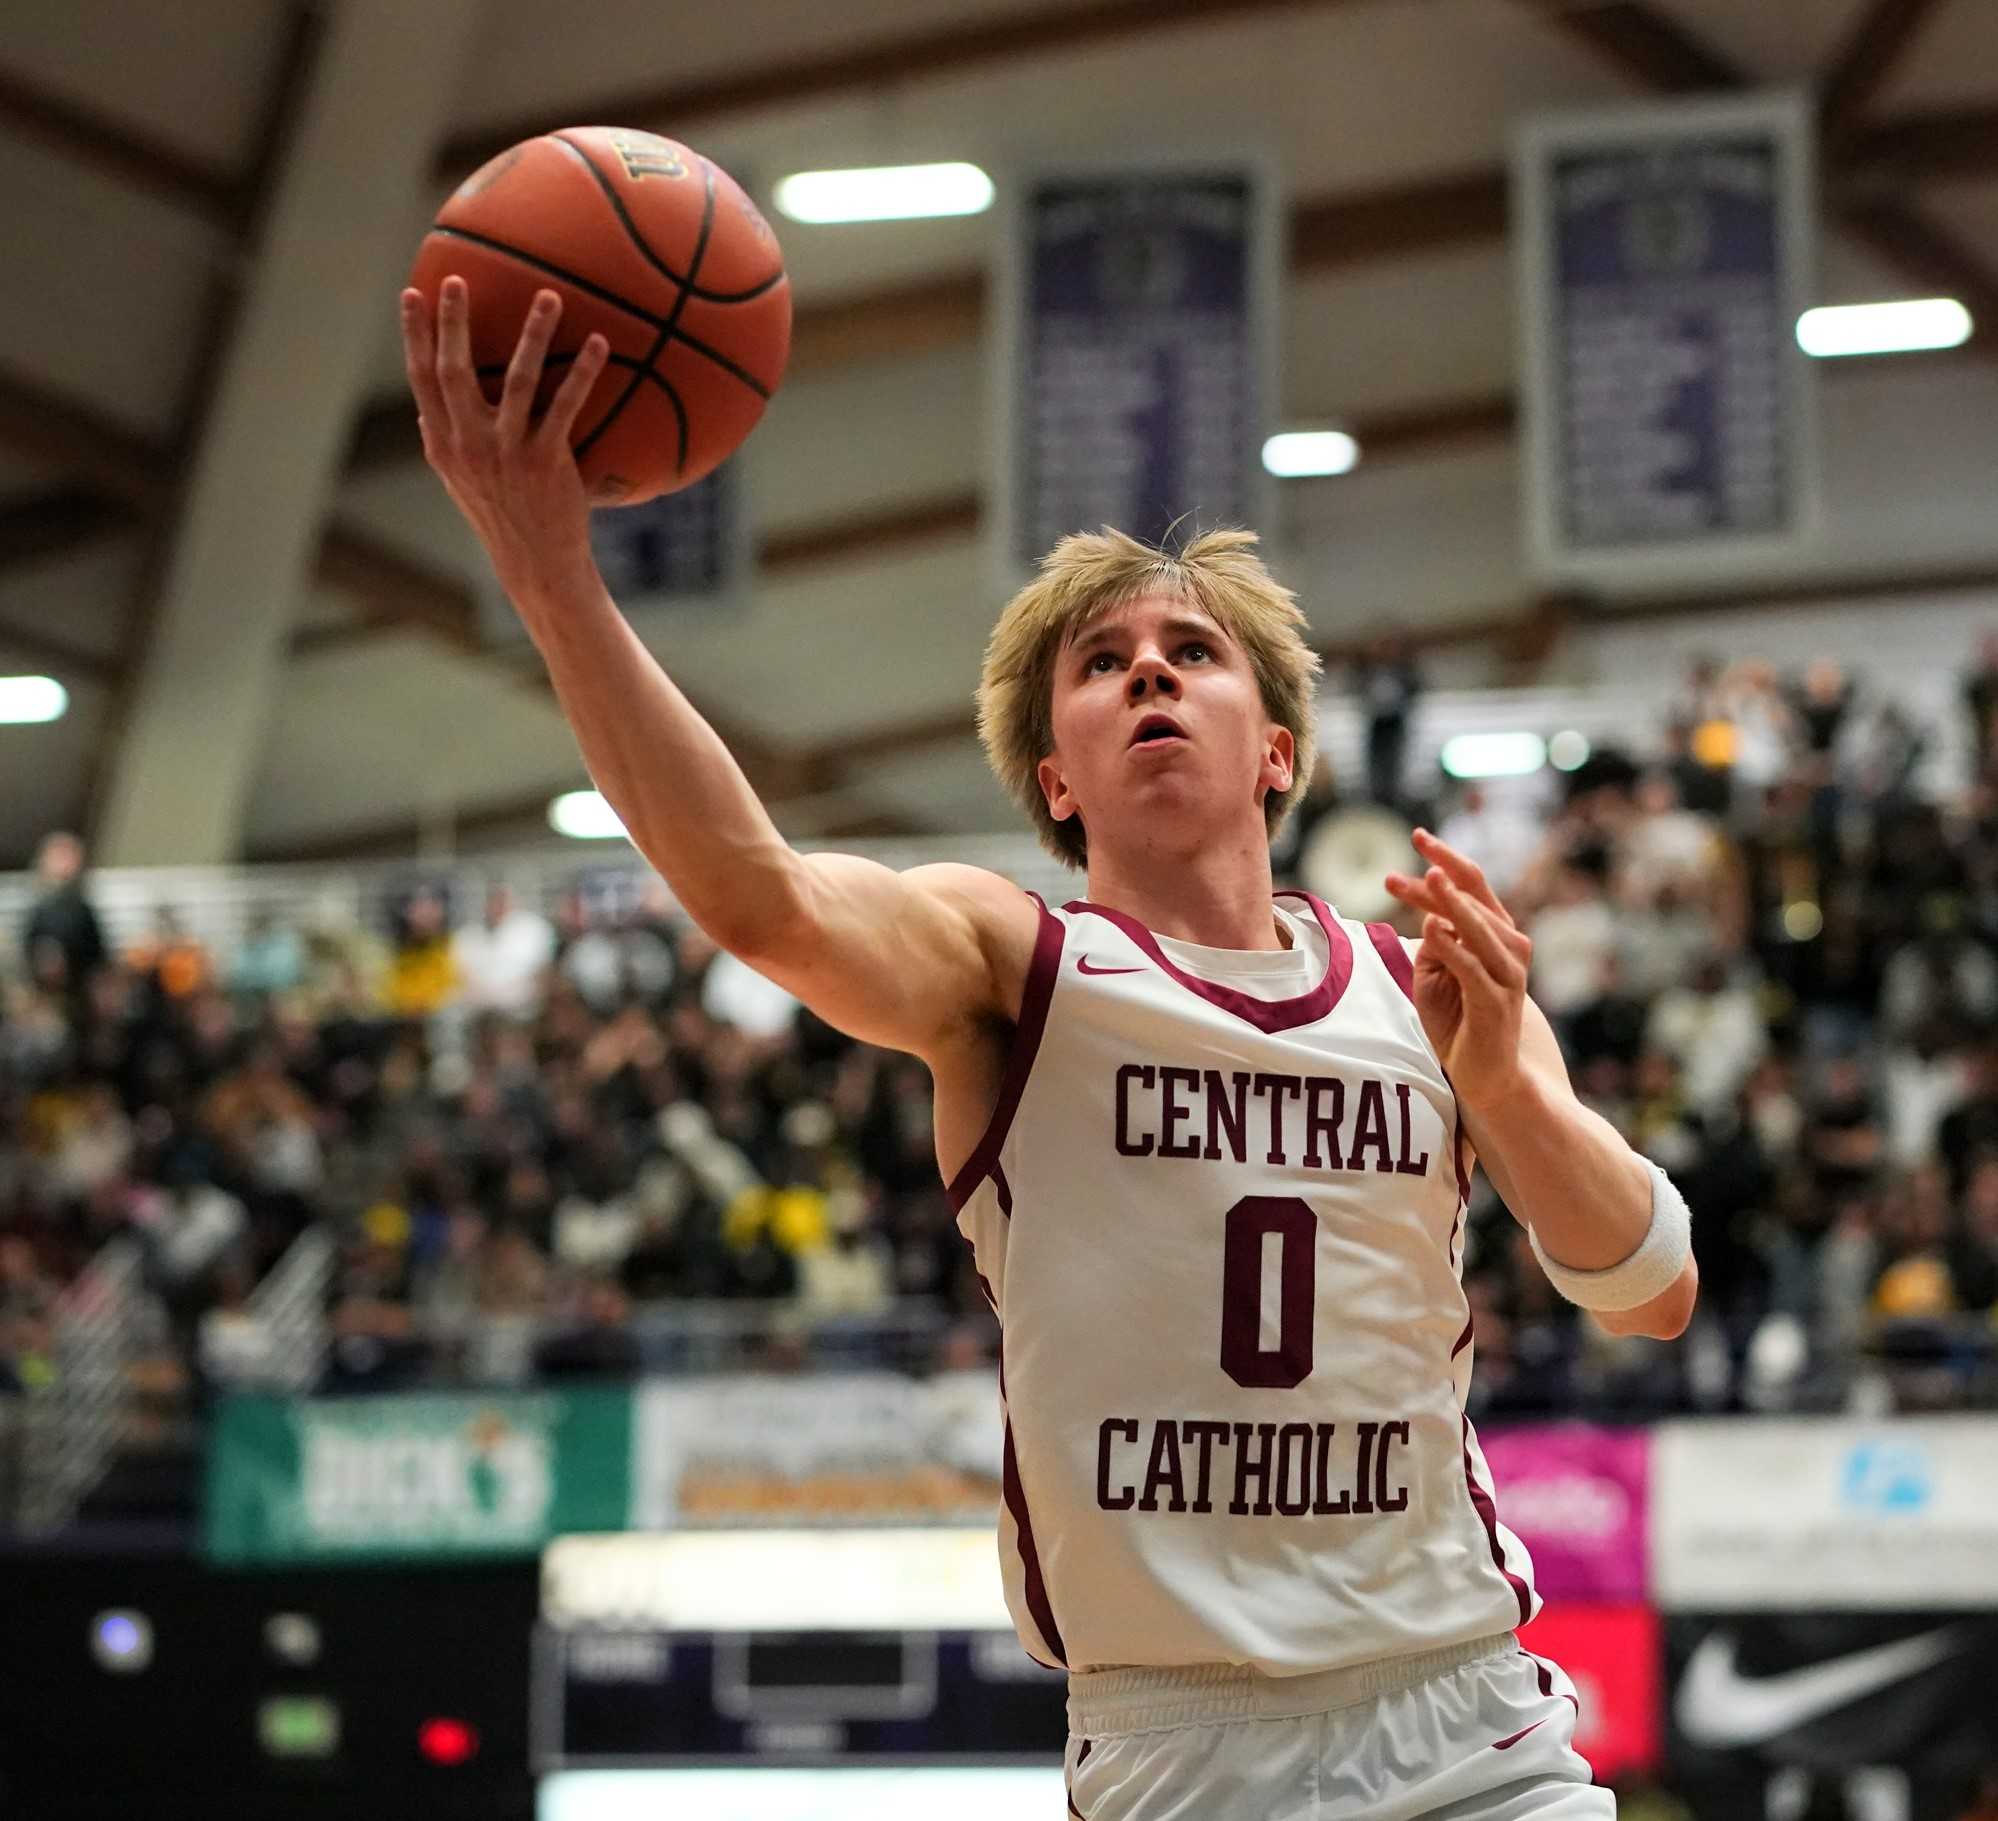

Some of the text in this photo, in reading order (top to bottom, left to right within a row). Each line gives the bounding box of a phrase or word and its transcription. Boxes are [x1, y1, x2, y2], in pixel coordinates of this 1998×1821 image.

[1115, 1063, 1429, 1177] CENTRAL
[1220, 1195, 1318, 1389] 0
[1097, 1417, 1410, 1517] CATHOLIC
